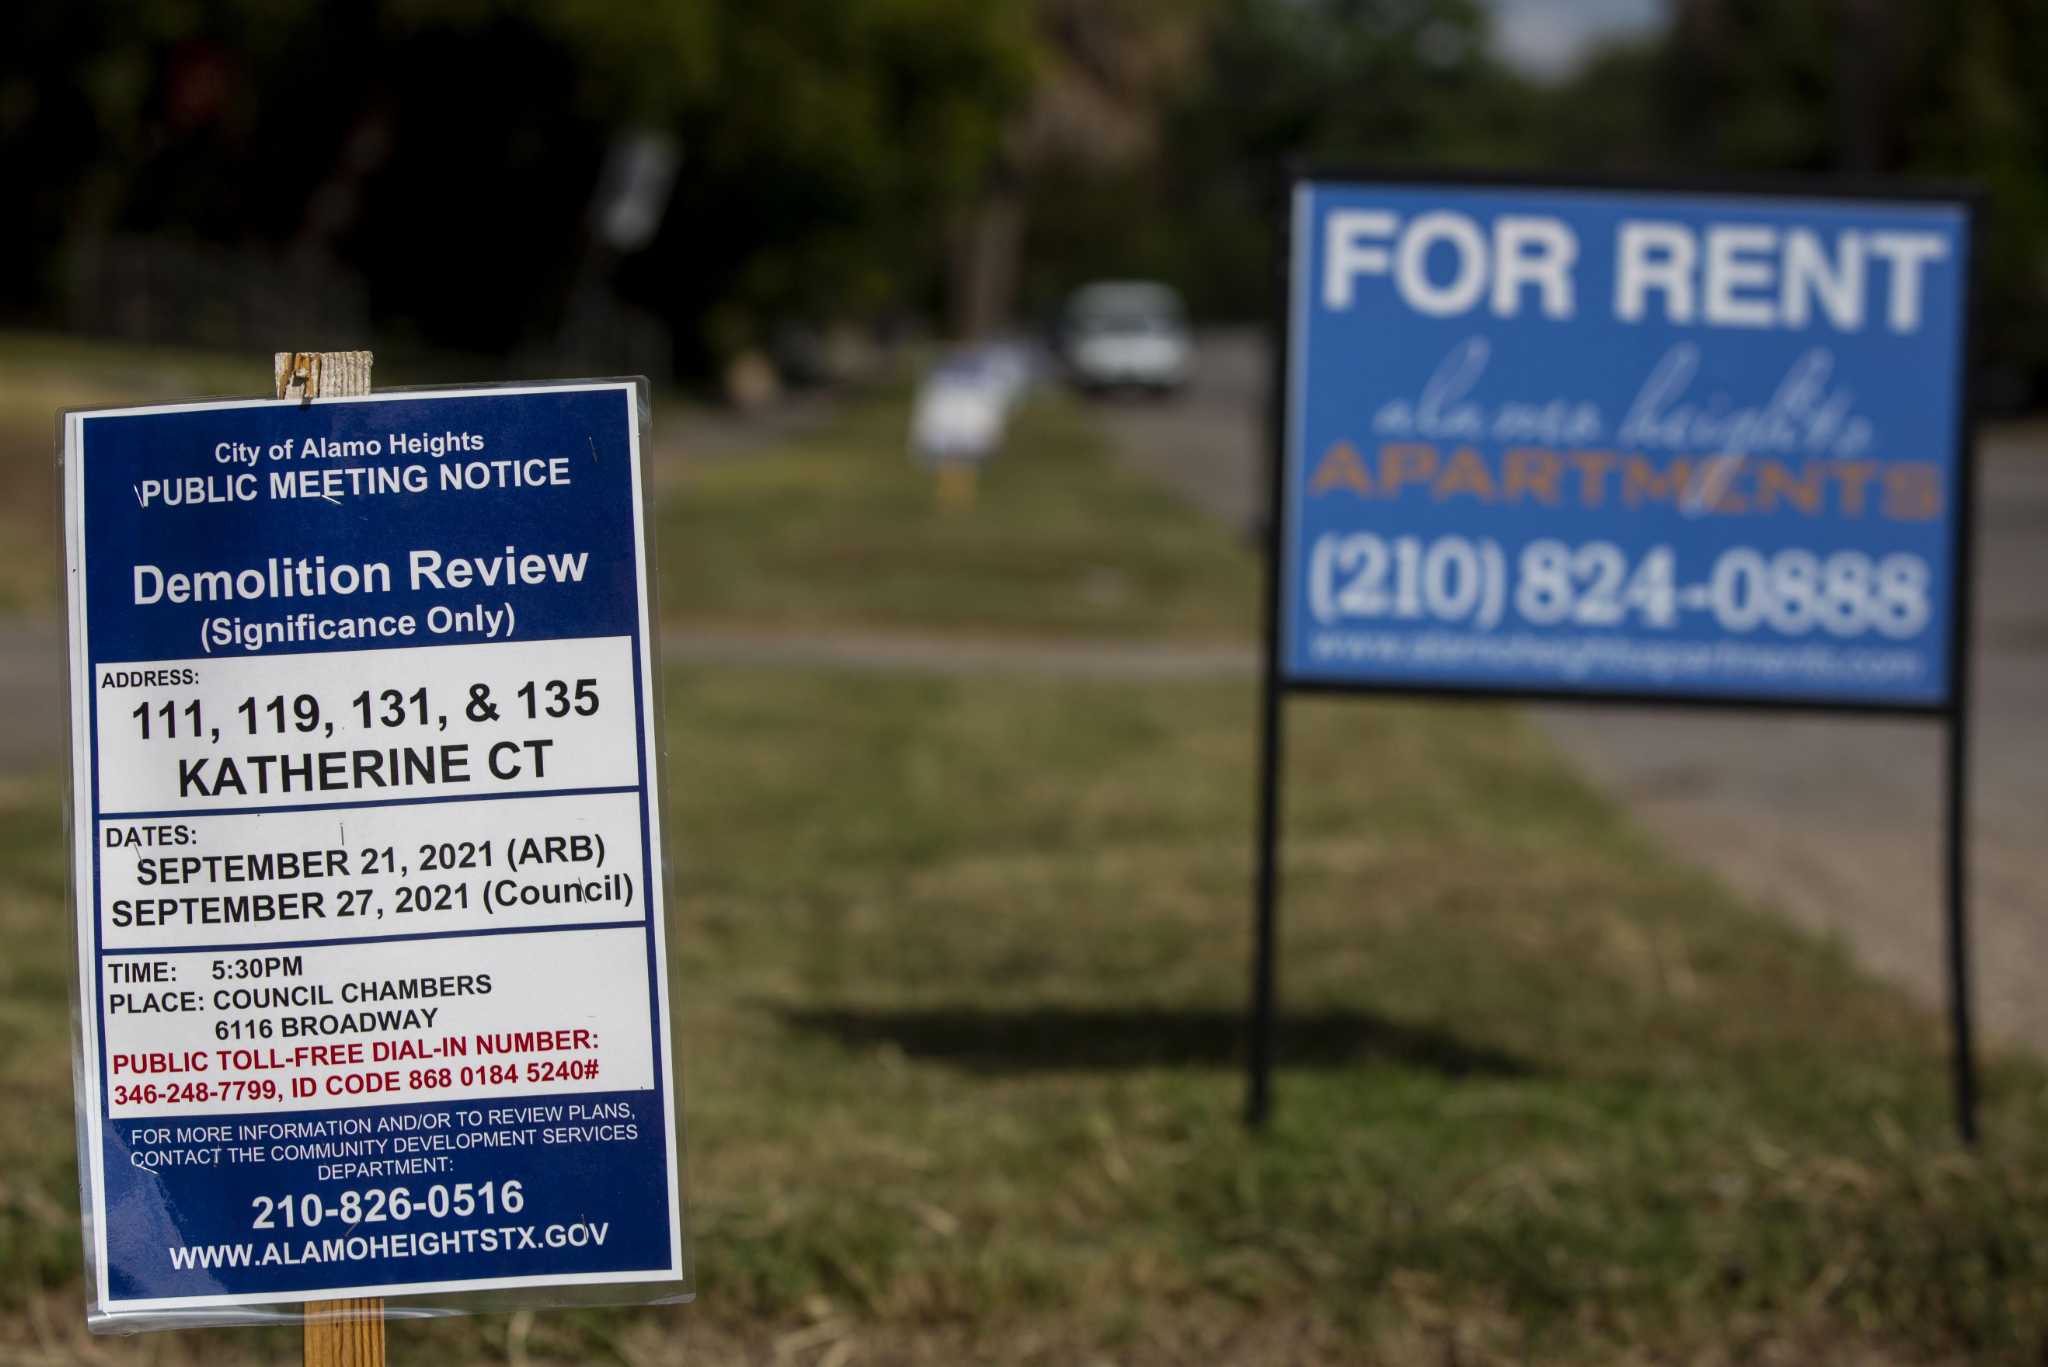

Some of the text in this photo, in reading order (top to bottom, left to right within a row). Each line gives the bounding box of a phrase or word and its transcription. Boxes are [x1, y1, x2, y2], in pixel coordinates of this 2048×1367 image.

[1323, 210, 1947, 332] FOR RENT
[215, 432, 484, 467] City of Alamo Heights
[142, 458, 571, 507] PUBLIC MEETING NOTICE
[1310, 441, 1944, 519] APARTMENTS
[134, 546, 588, 605] Demolition Review
[1309, 531, 1930, 638] (210) 824-0888
[202, 602, 515, 653] (Significance Only)
[101, 668, 199, 688] ADDRESS:
[133, 678, 599, 744] 111, 119, 131, & 135
[179, 739, 553, 797] KATHERINE CT
[106, 825, 196, 848] DATES:
[137, 834, 605, 885] SEPTEMBER 21, 2021 (ARB)
[112, 873, 633, 927] SEPTEMBER 27, 2021 (Council)
[108, 956, 302, 983] TIME: 5:30PM
[110, 974, 492, 1014] PLACE: COUNCIL CHAMBERS
[215, 1007, 438, 1040] 6116 BROADWAY
[113, 1029, 598, 1074] PUBLIC TOLL-FREE DIAL-IN NUMBER:
[115, 1059, 599, 1105] 346-248-7799, ID CODE 868 0184 5240#
[131, 1124, 638, 1168] CONTACT THE COMMUNITY DEVELOPMENT SERVICES
[132, 1102, 635, 1145] FOR MORE INFORMATION AND/OR TO REVIEW PLANS,
[318, 1156, 453, 1181] DEPARTMENT:
[252, 1180, 524, 1229] 210-826-0516
[169, 1222, 608, 1270] WWW.ALAMOHEIGHTSTX.GOV
